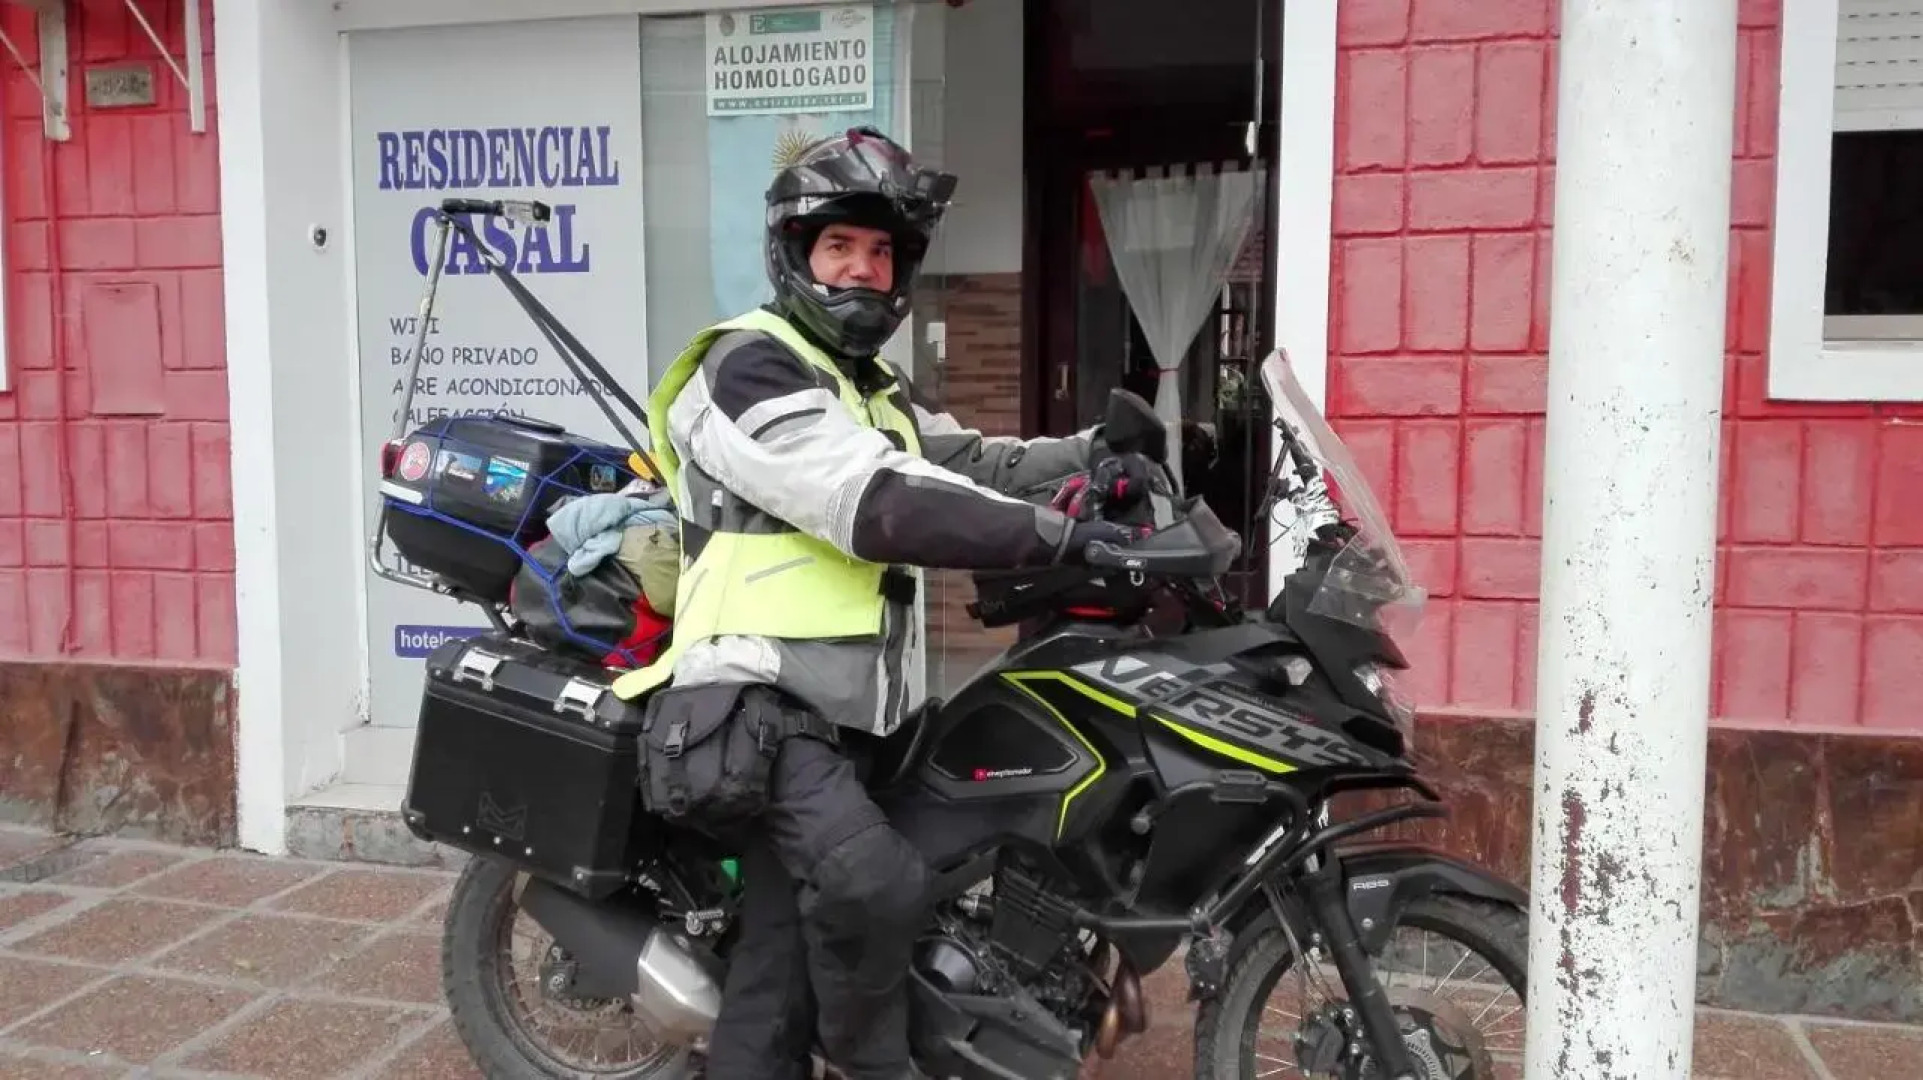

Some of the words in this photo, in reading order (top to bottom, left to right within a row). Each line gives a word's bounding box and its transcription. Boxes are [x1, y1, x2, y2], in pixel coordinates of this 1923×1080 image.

[714, 39, 866, 65] ALOJAMIENTO
[714, 65, 866, 90] HOMOLOGADO
[377, 126, 619, 190] RESIDENCIAL
[410, 204, 590, 276] CASAL
[390, 317, 440, 335] WII
[452, 347, 539, 366] PRIVADO
[393, 377, 437, 396] ARE
[1100, 655, 1364, 766] VERSYS
